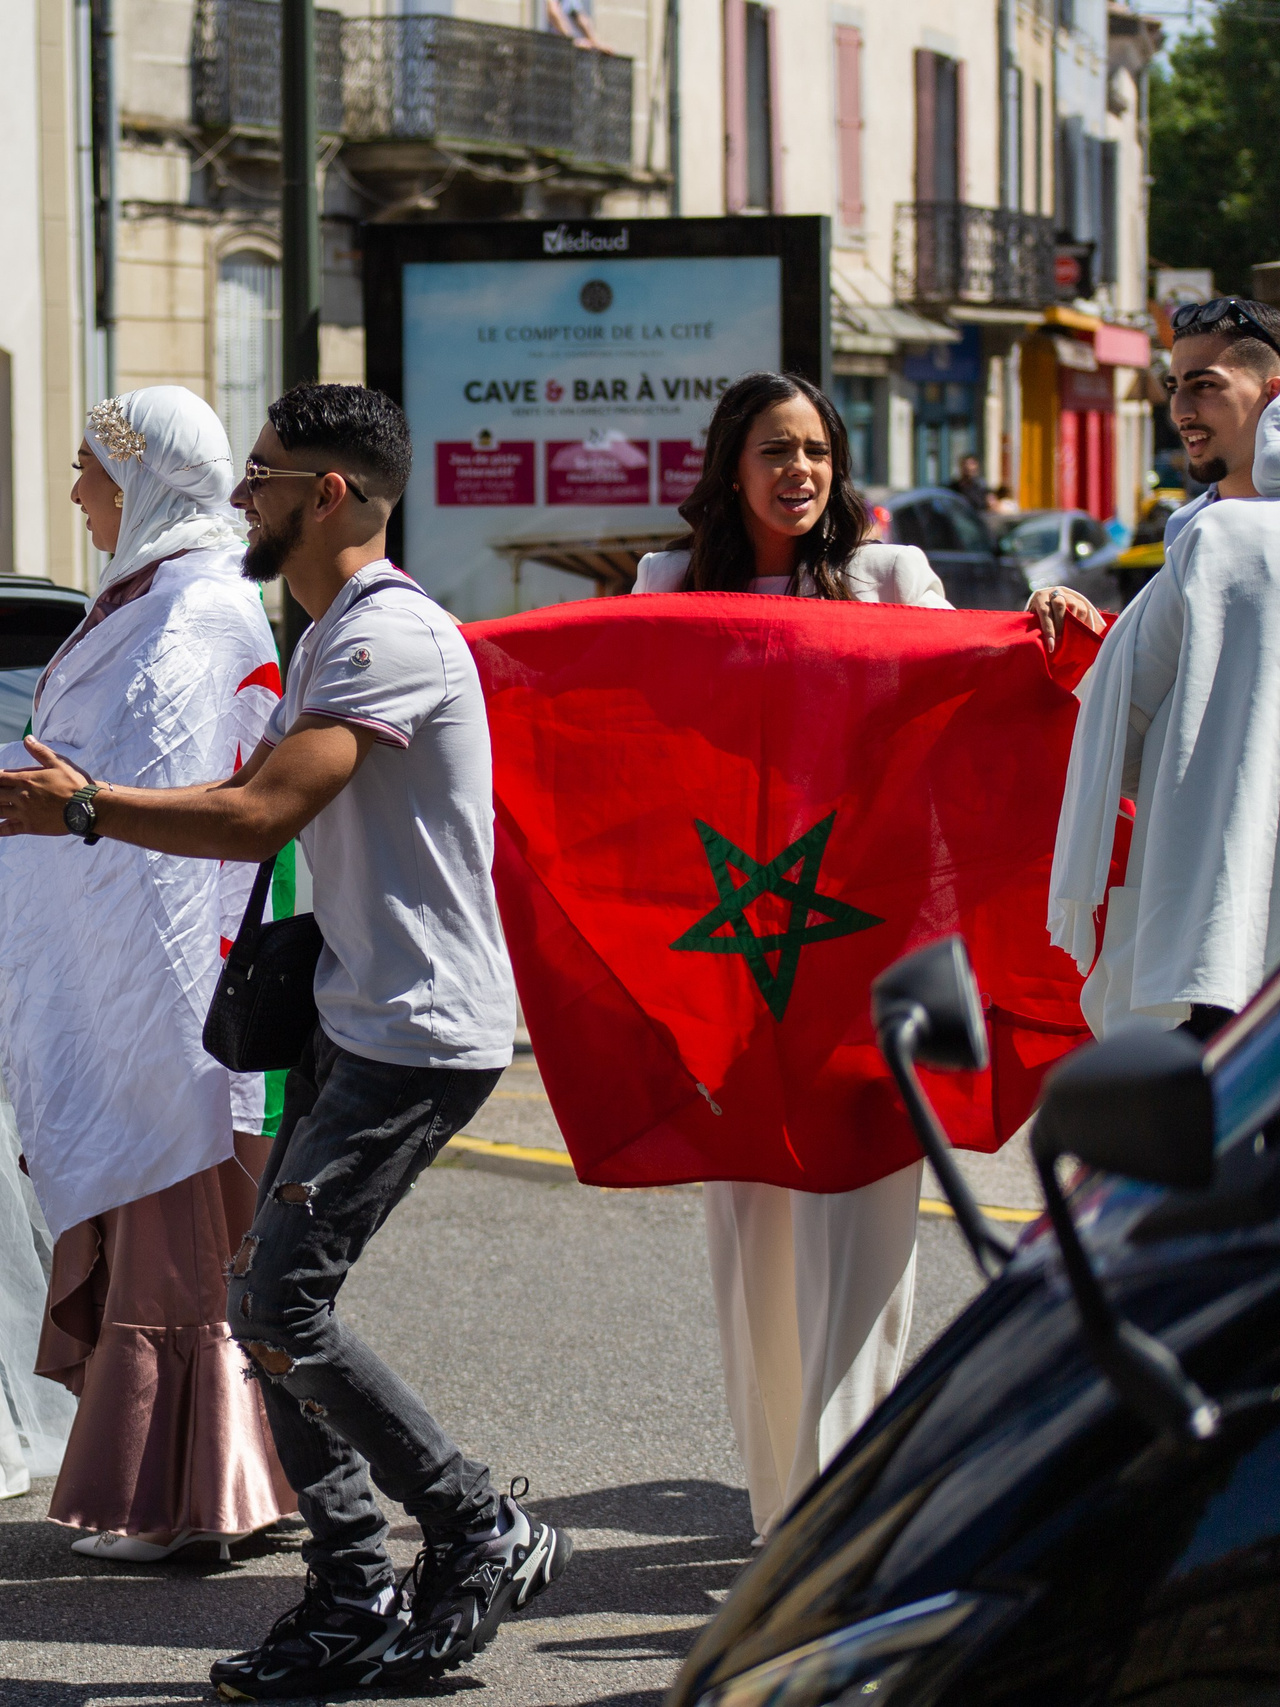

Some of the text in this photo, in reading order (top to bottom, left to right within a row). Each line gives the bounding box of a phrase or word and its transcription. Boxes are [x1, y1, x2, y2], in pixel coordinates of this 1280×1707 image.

[477, 319, 714, 343] LE COMPTOIR DE LA CITÉ
[464, 371, 731, 403] CAVE & BAR À VINS
